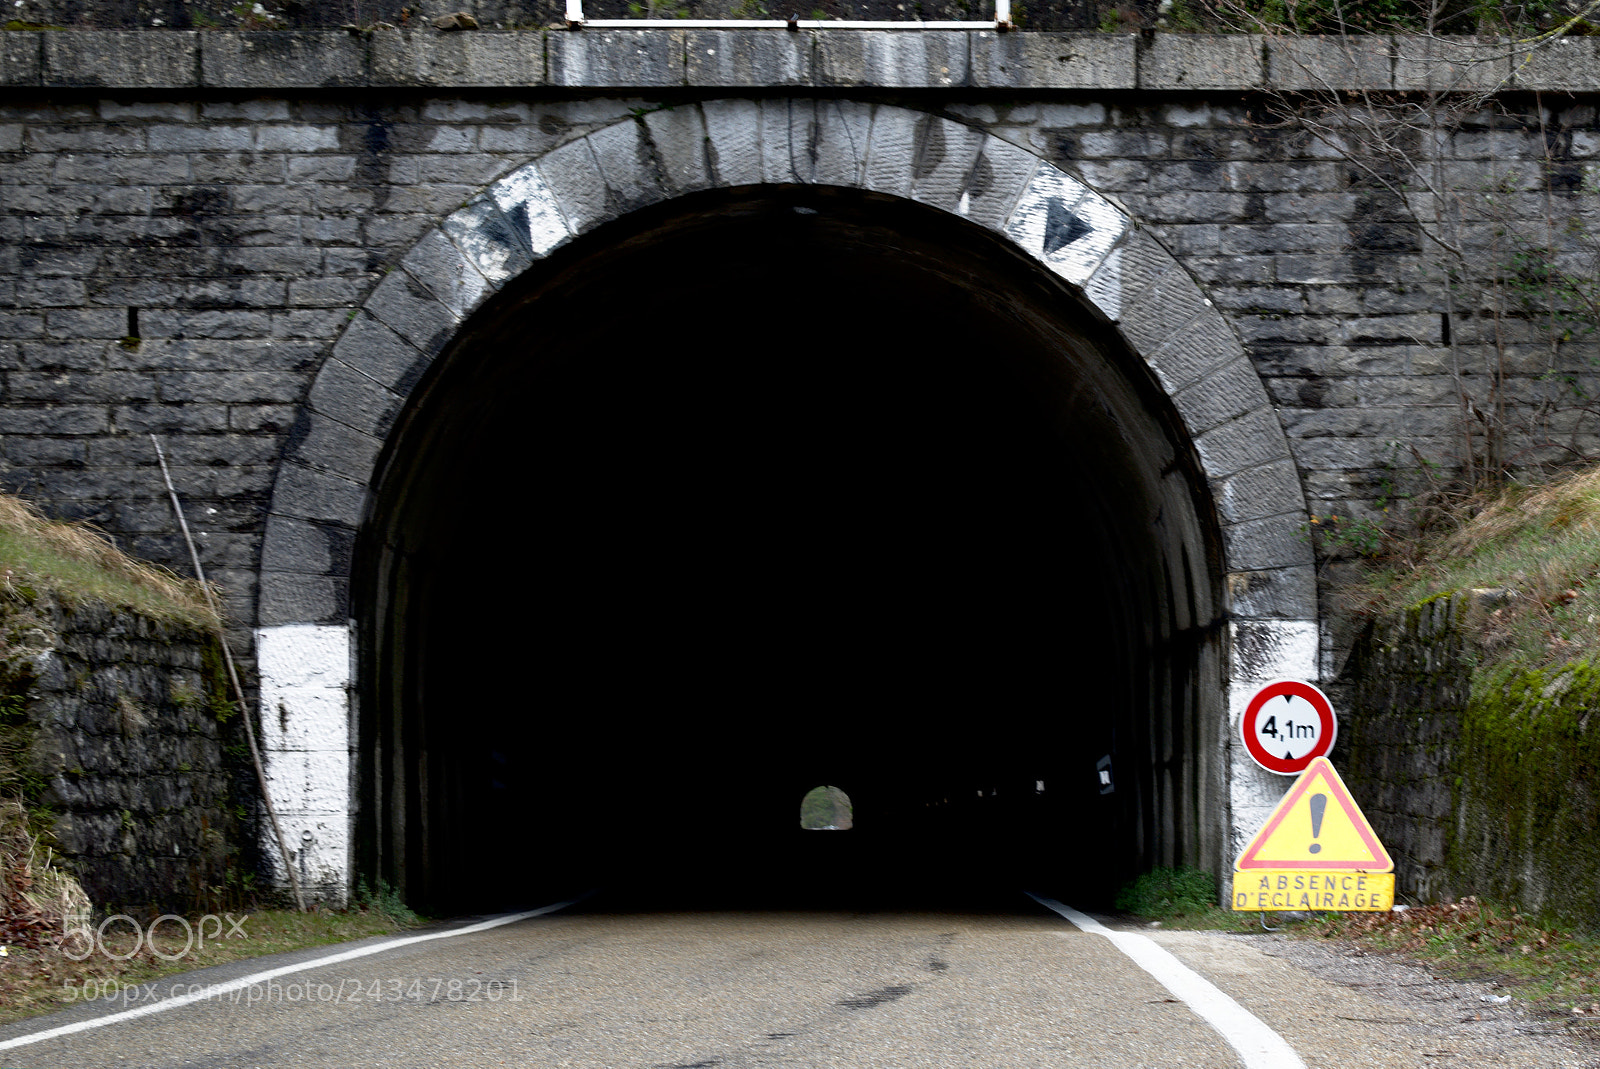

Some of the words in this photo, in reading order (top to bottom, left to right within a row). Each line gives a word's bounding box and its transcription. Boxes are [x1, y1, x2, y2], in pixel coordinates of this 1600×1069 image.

[1262, 715, 1315, 742] 4,1m
[1259, 875, 1367, 891] ABSENCE
[1236, 892, 1381, 908] D'ECLAIRAGE
